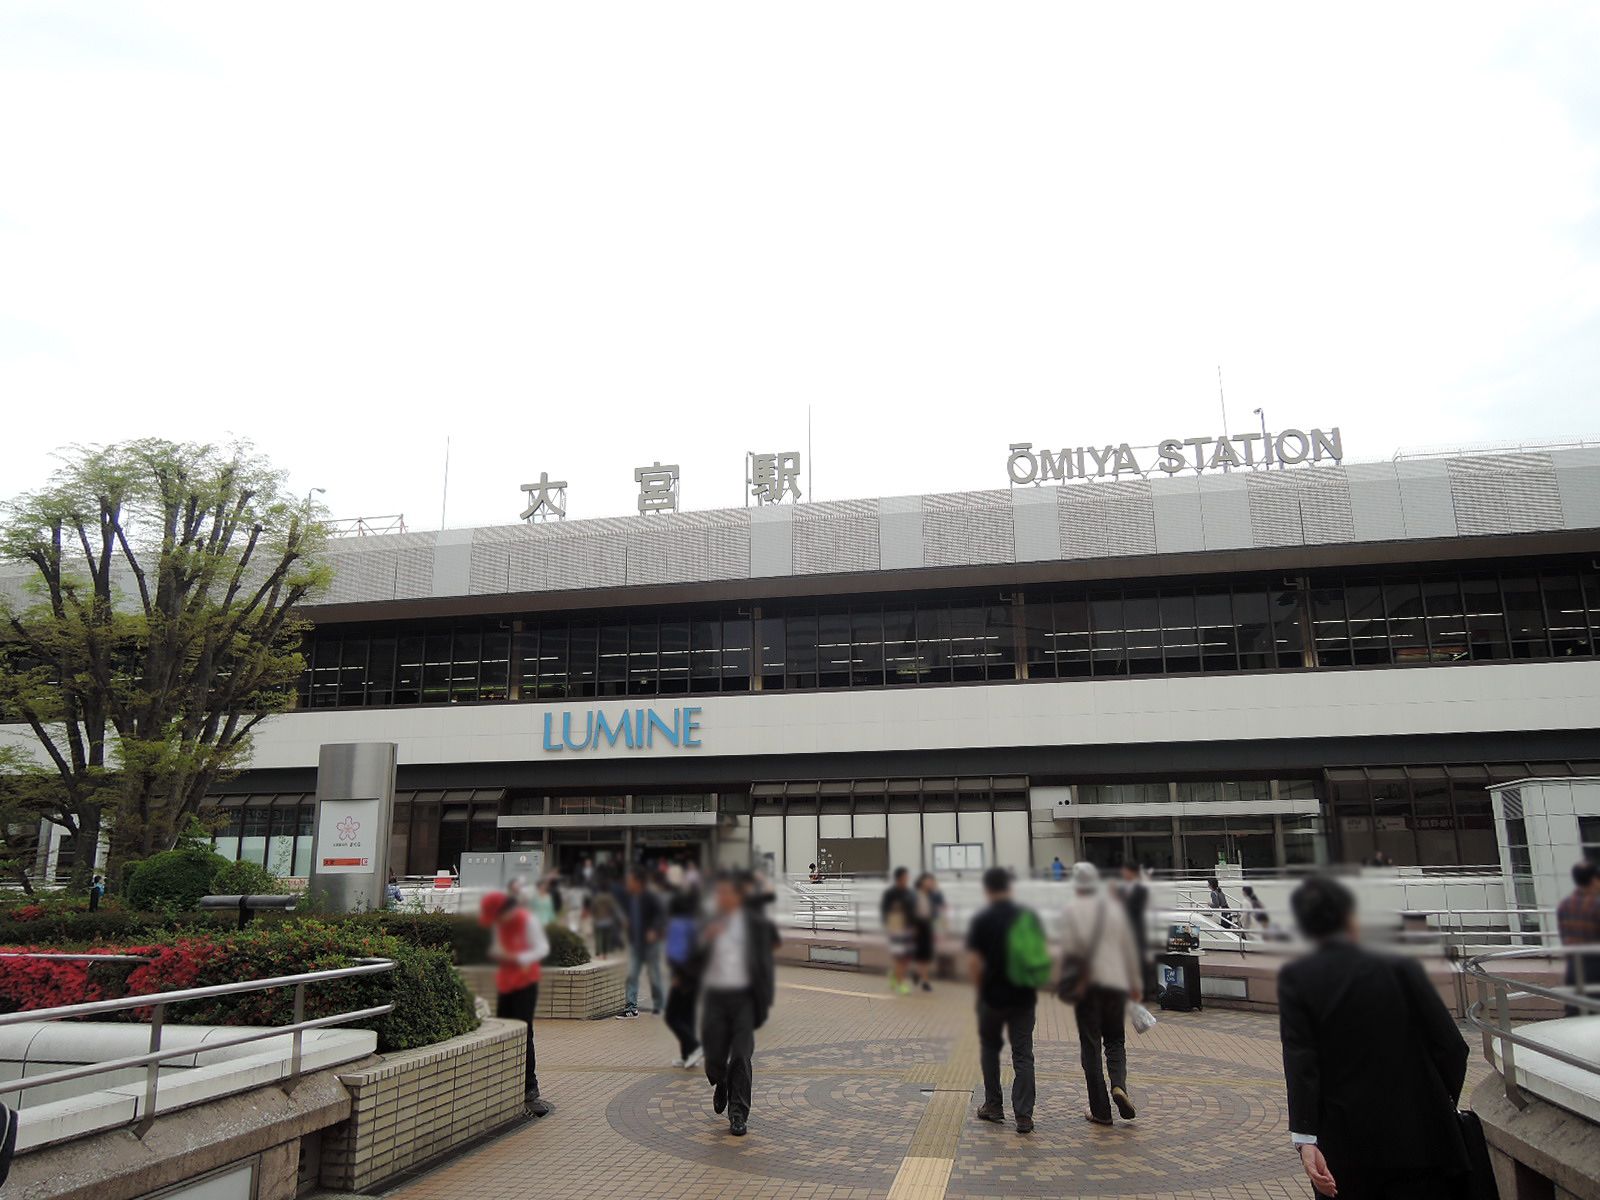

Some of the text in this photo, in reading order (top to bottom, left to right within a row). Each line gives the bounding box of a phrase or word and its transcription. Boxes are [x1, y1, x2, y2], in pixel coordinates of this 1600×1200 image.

[1007, 428, 1344, 484] ŌMIYA STATION
[520, 451, 802, 520] 大宮駅
[543, 707, 702, 751] LUMINE
